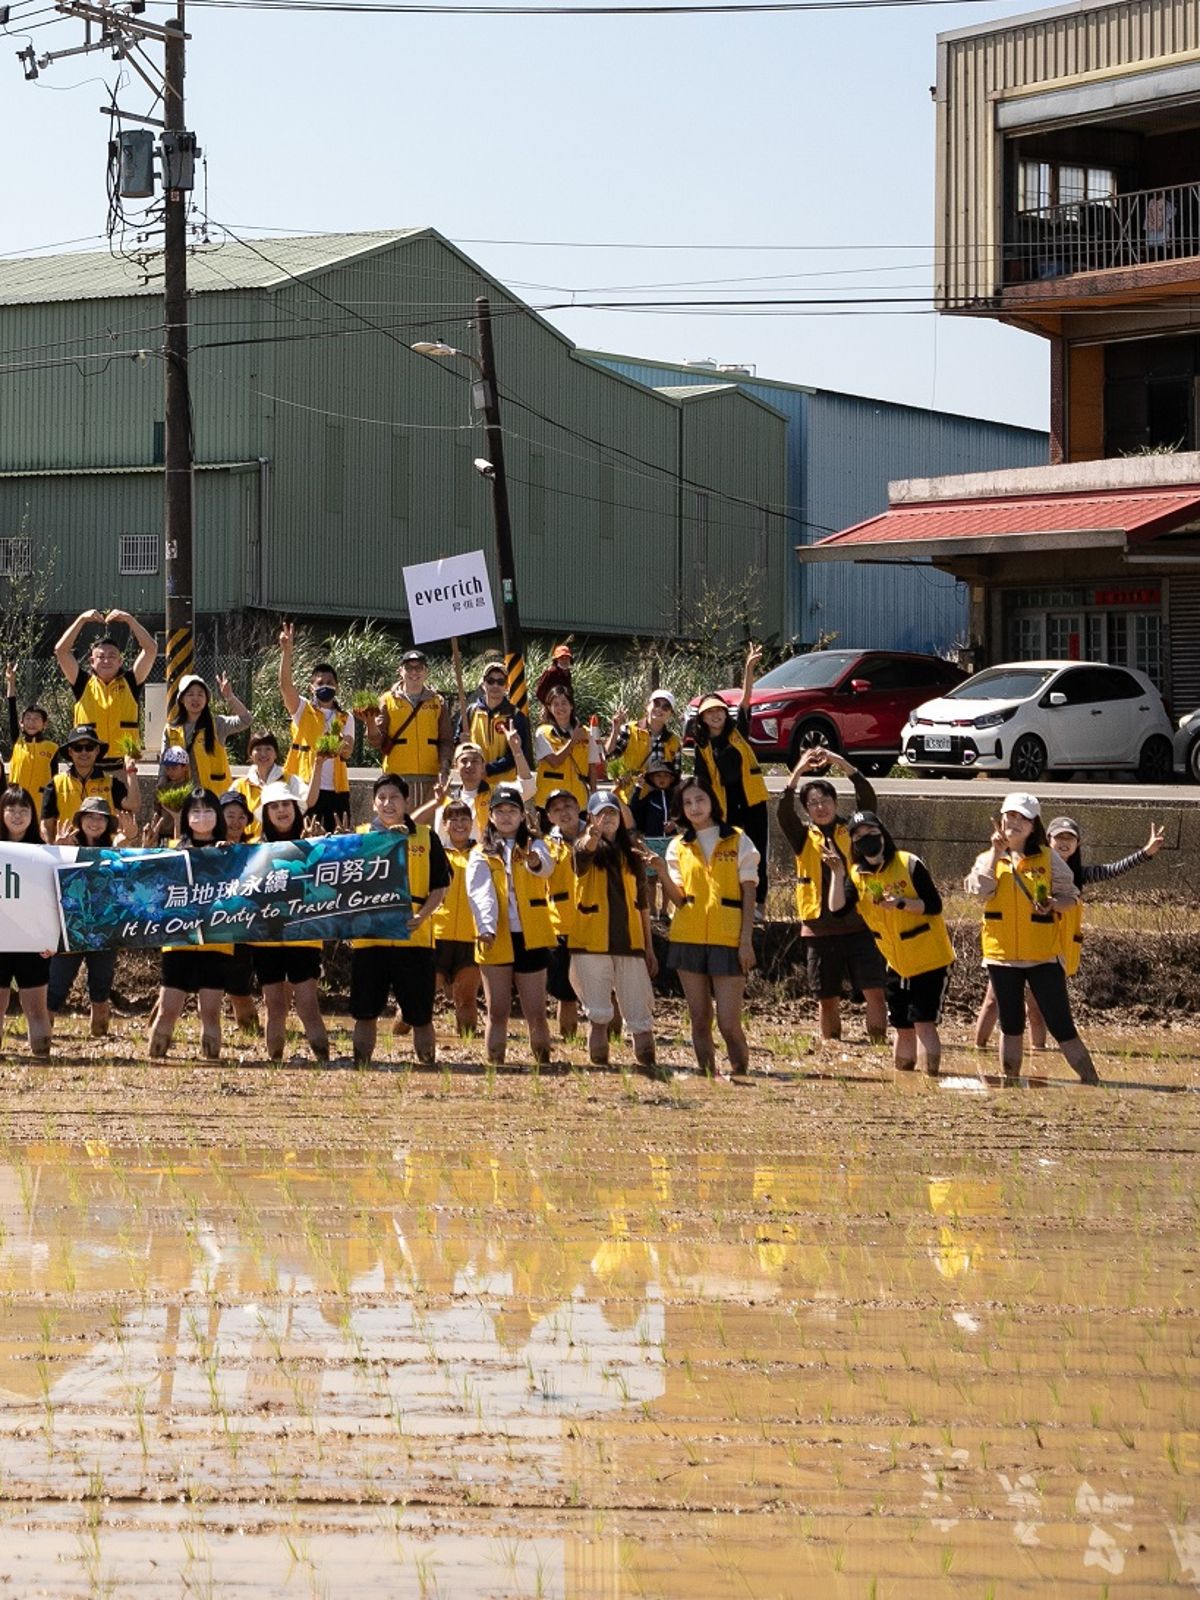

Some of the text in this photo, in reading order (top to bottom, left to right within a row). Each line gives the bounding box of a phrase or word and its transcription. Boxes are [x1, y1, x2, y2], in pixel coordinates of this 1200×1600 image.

[415, 576, 483, 606] everrich
[122, 890, 401, 938] It Is Our Duty to Travel Green
